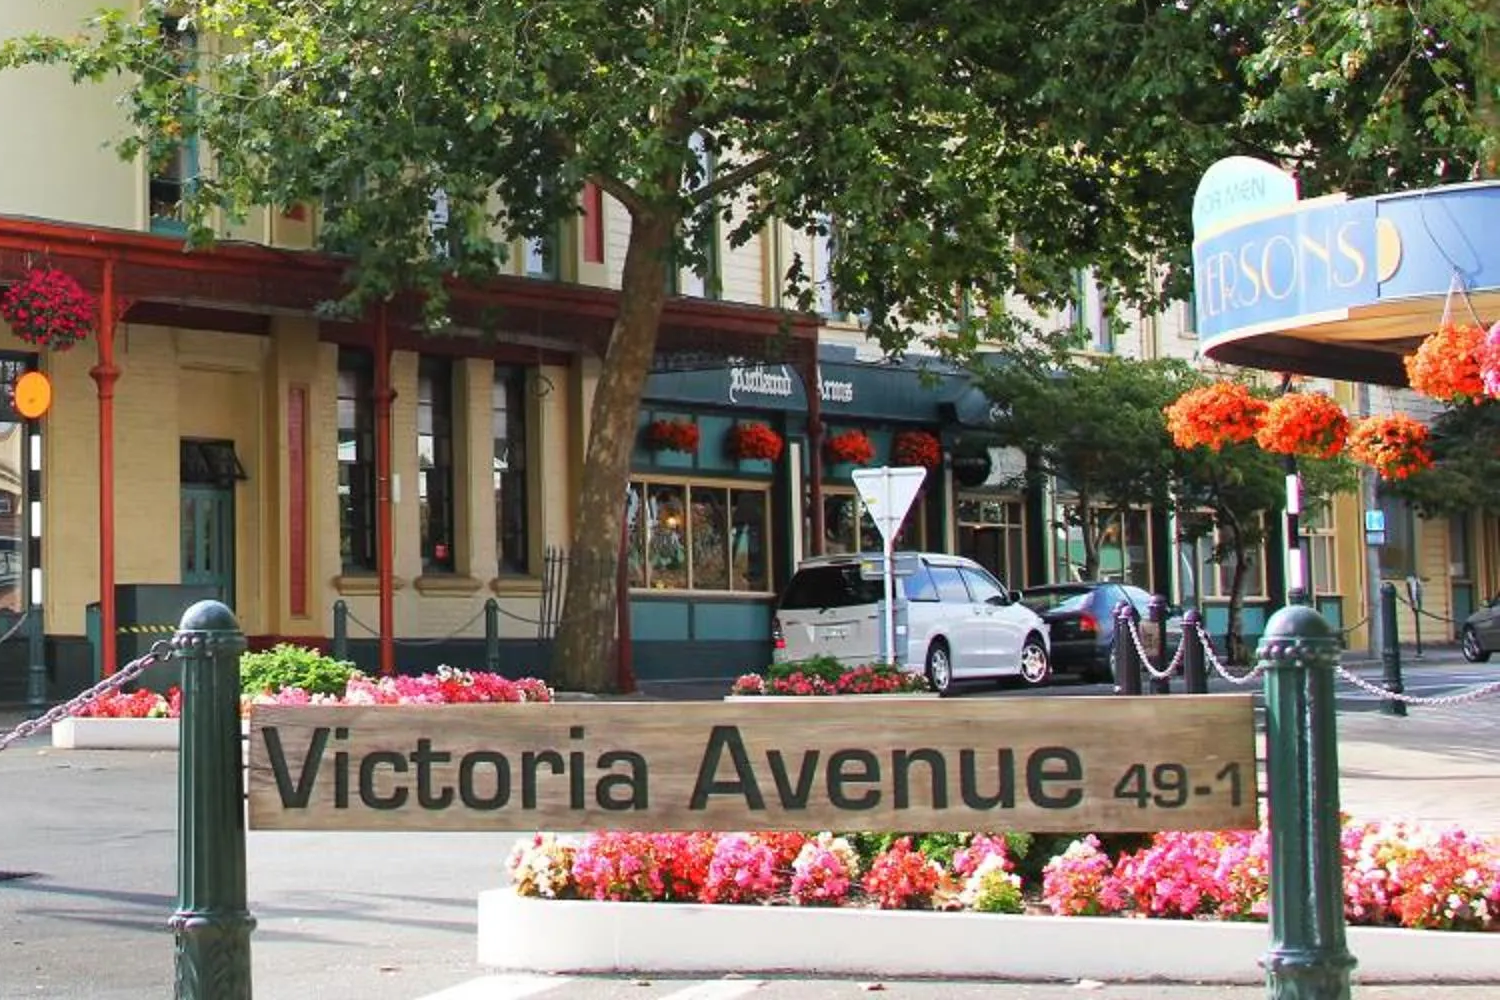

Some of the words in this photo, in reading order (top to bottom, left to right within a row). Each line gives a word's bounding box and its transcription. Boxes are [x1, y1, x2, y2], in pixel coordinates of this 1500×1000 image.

[1201, 220, 1365, 319] ERSONS
[727, 356, 793, 403] Rutland
[261, 725, 649, 812] Victoria
[689, 724, 1084, 812] Avenue
[1113, 761, 1242, 809] 49-1
